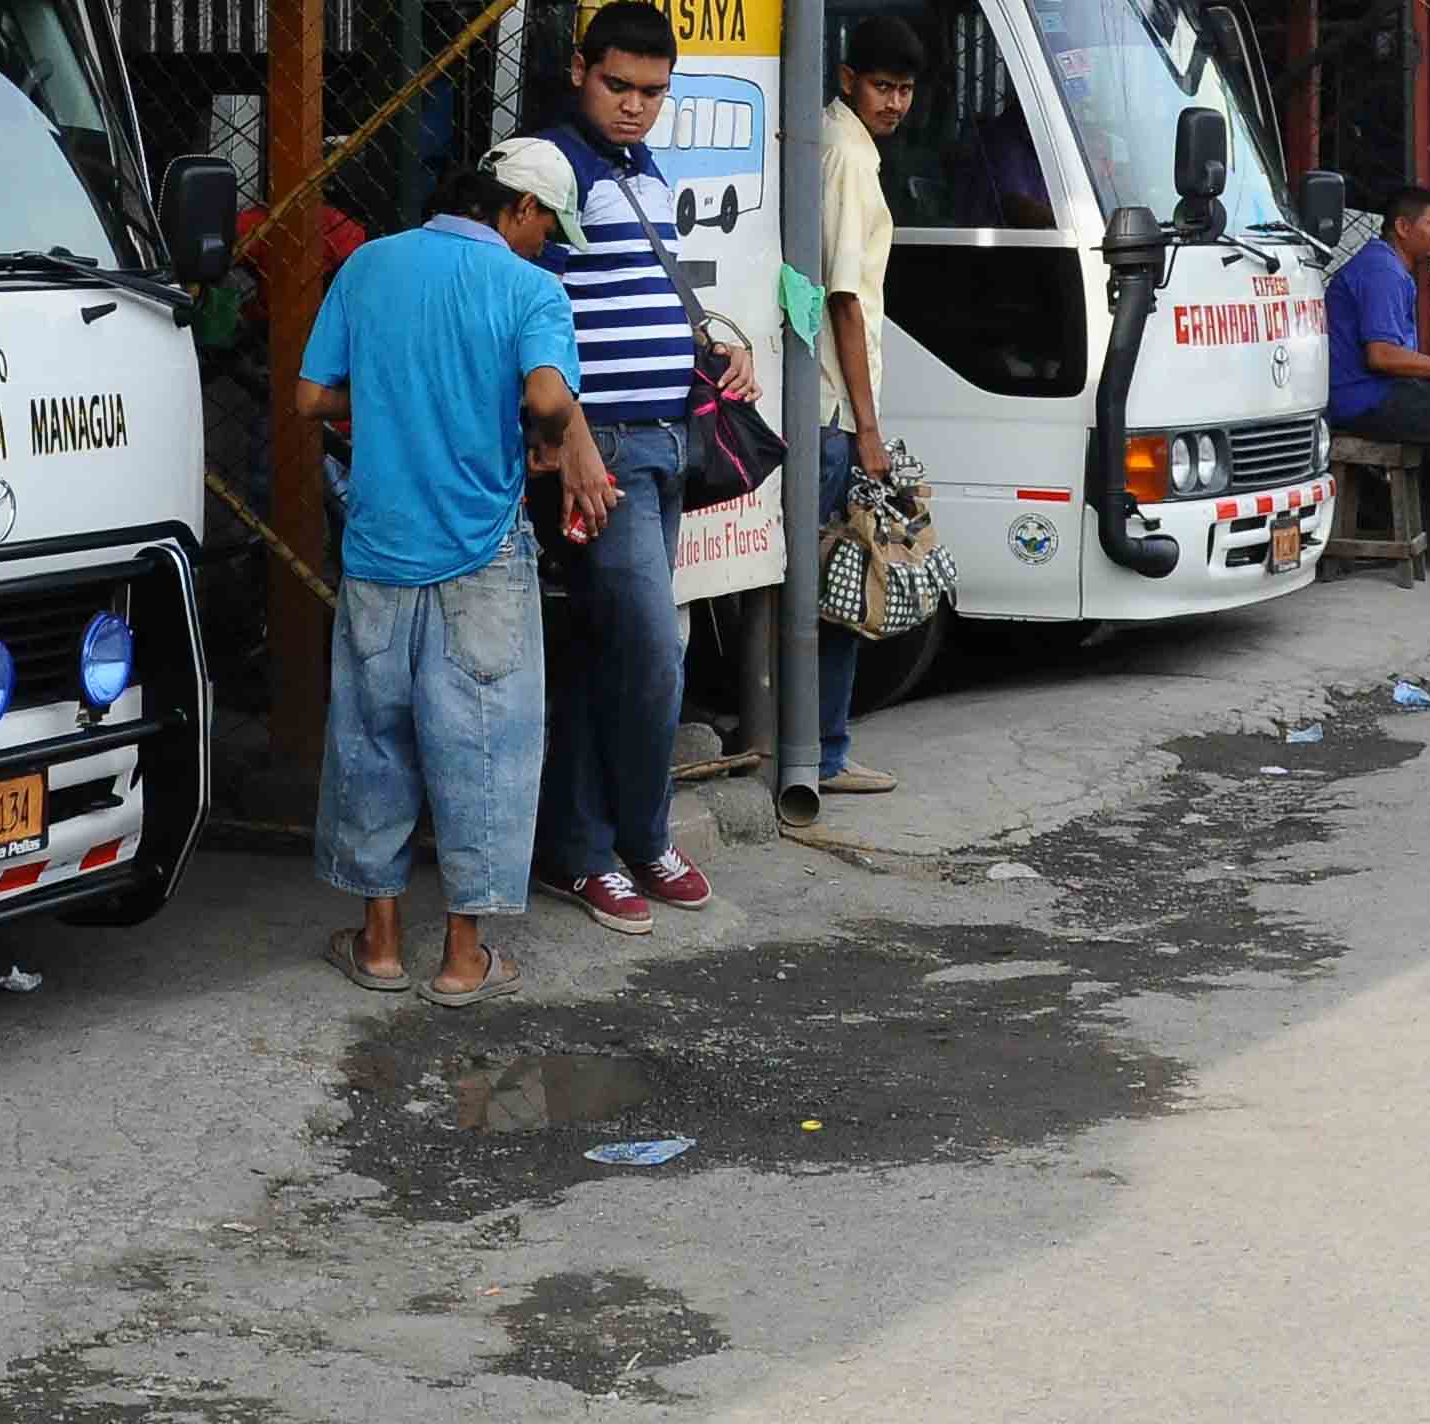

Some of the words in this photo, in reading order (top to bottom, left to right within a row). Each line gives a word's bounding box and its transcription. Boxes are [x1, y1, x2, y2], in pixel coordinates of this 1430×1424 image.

[1173, 303, 1260, 346] GRANADA
[1262, 300, 1290, 342] UCA
[30, 393, 129, 456] MANAGUA
[704, 525, 722, 562] las
[7, 838, 42, 857] Pellas
